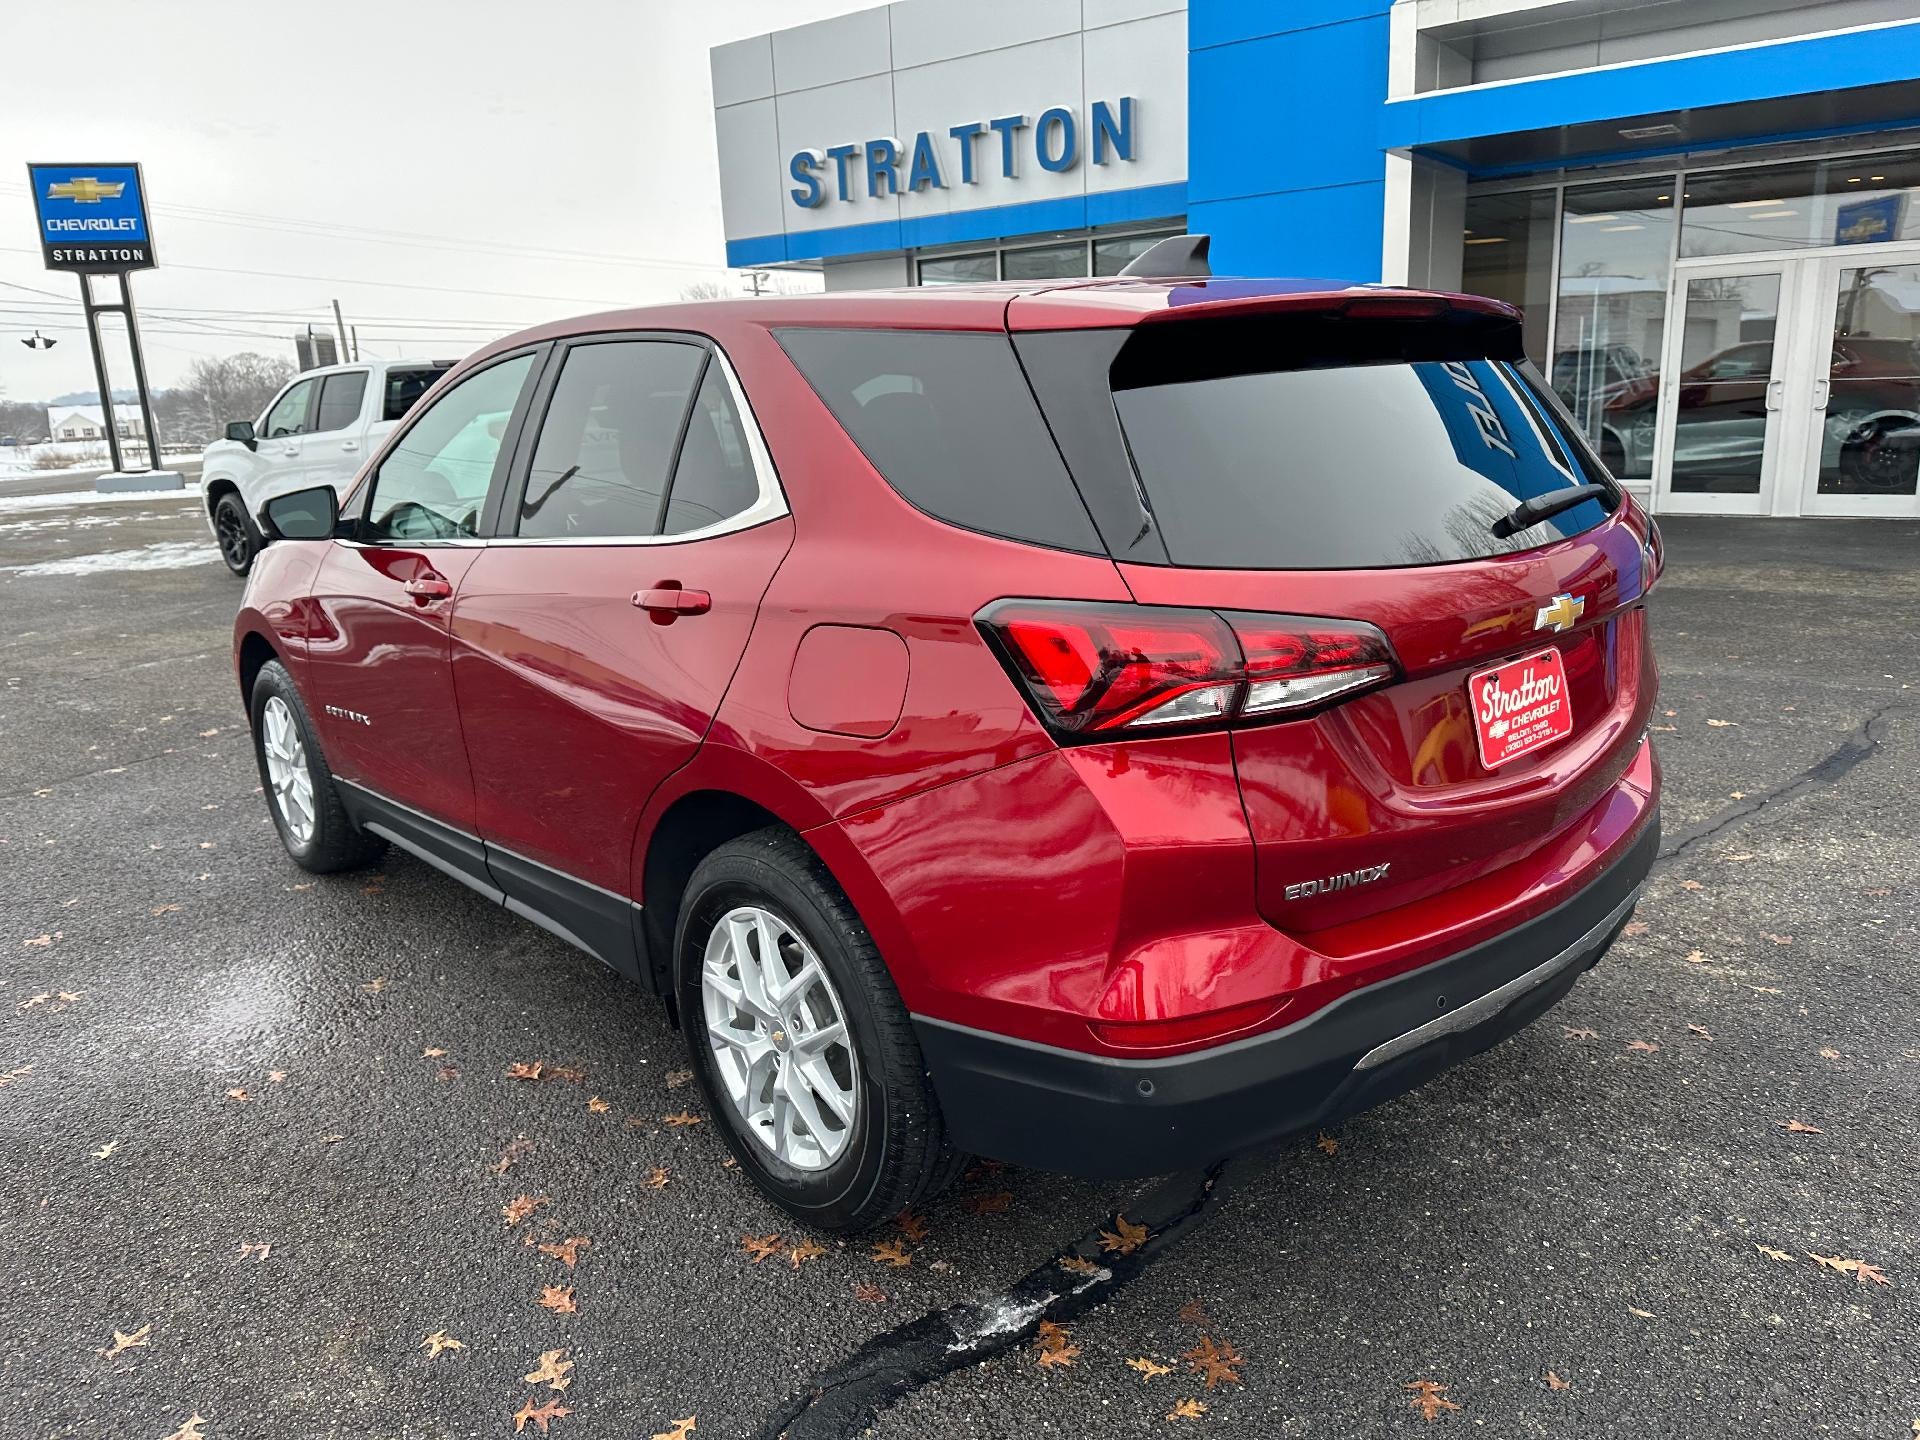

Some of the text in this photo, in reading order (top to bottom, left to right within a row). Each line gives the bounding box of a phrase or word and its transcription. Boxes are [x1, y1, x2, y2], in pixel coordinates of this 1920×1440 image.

[790, 97, 1137, 208] STRATTON
[47, 218, 137, 231] CHEVROLET
[53, 249, 144, 261] STRATTON
[1481, 668, 1560, 723] Stratton
[1512, 699, 1561, 729] CHEVROLET
[1285, 863, 1391, 900] EQUINOX
